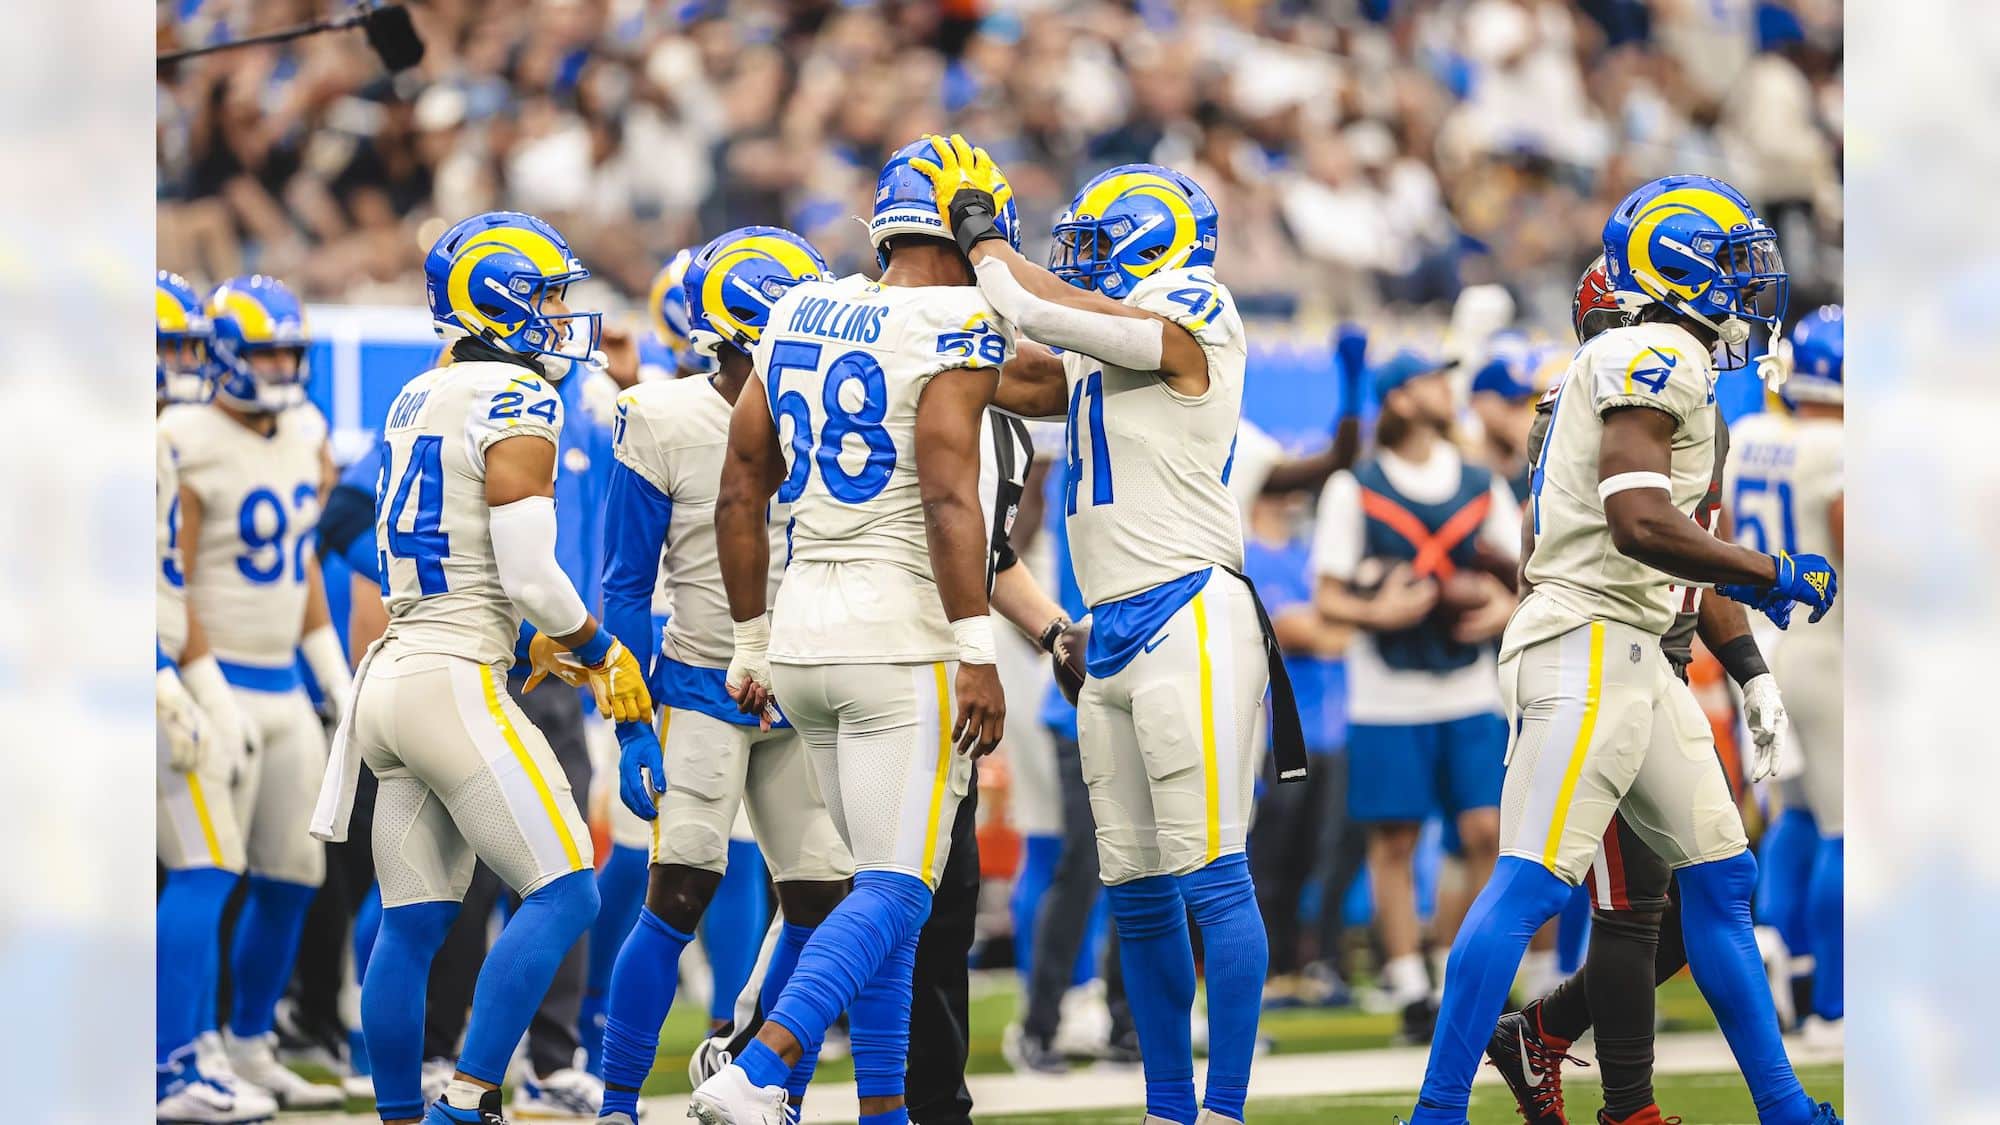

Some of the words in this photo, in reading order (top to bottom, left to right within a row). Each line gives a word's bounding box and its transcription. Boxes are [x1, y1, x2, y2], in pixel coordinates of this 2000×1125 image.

[871, 217, 887, 229] LOS
[887, 215, 942, 227] ANGELES
[788, 295, 889, 344] HOLLINS
[1167, 287, 1225, 325] 41
[936, 332, 1006, 365] 58
[1631, 367, 1672, 394] 4
[488, 391, 558, 425] 24
[767, 340, 897, 504] 58
[1734, 477, 1797, 556] 51
